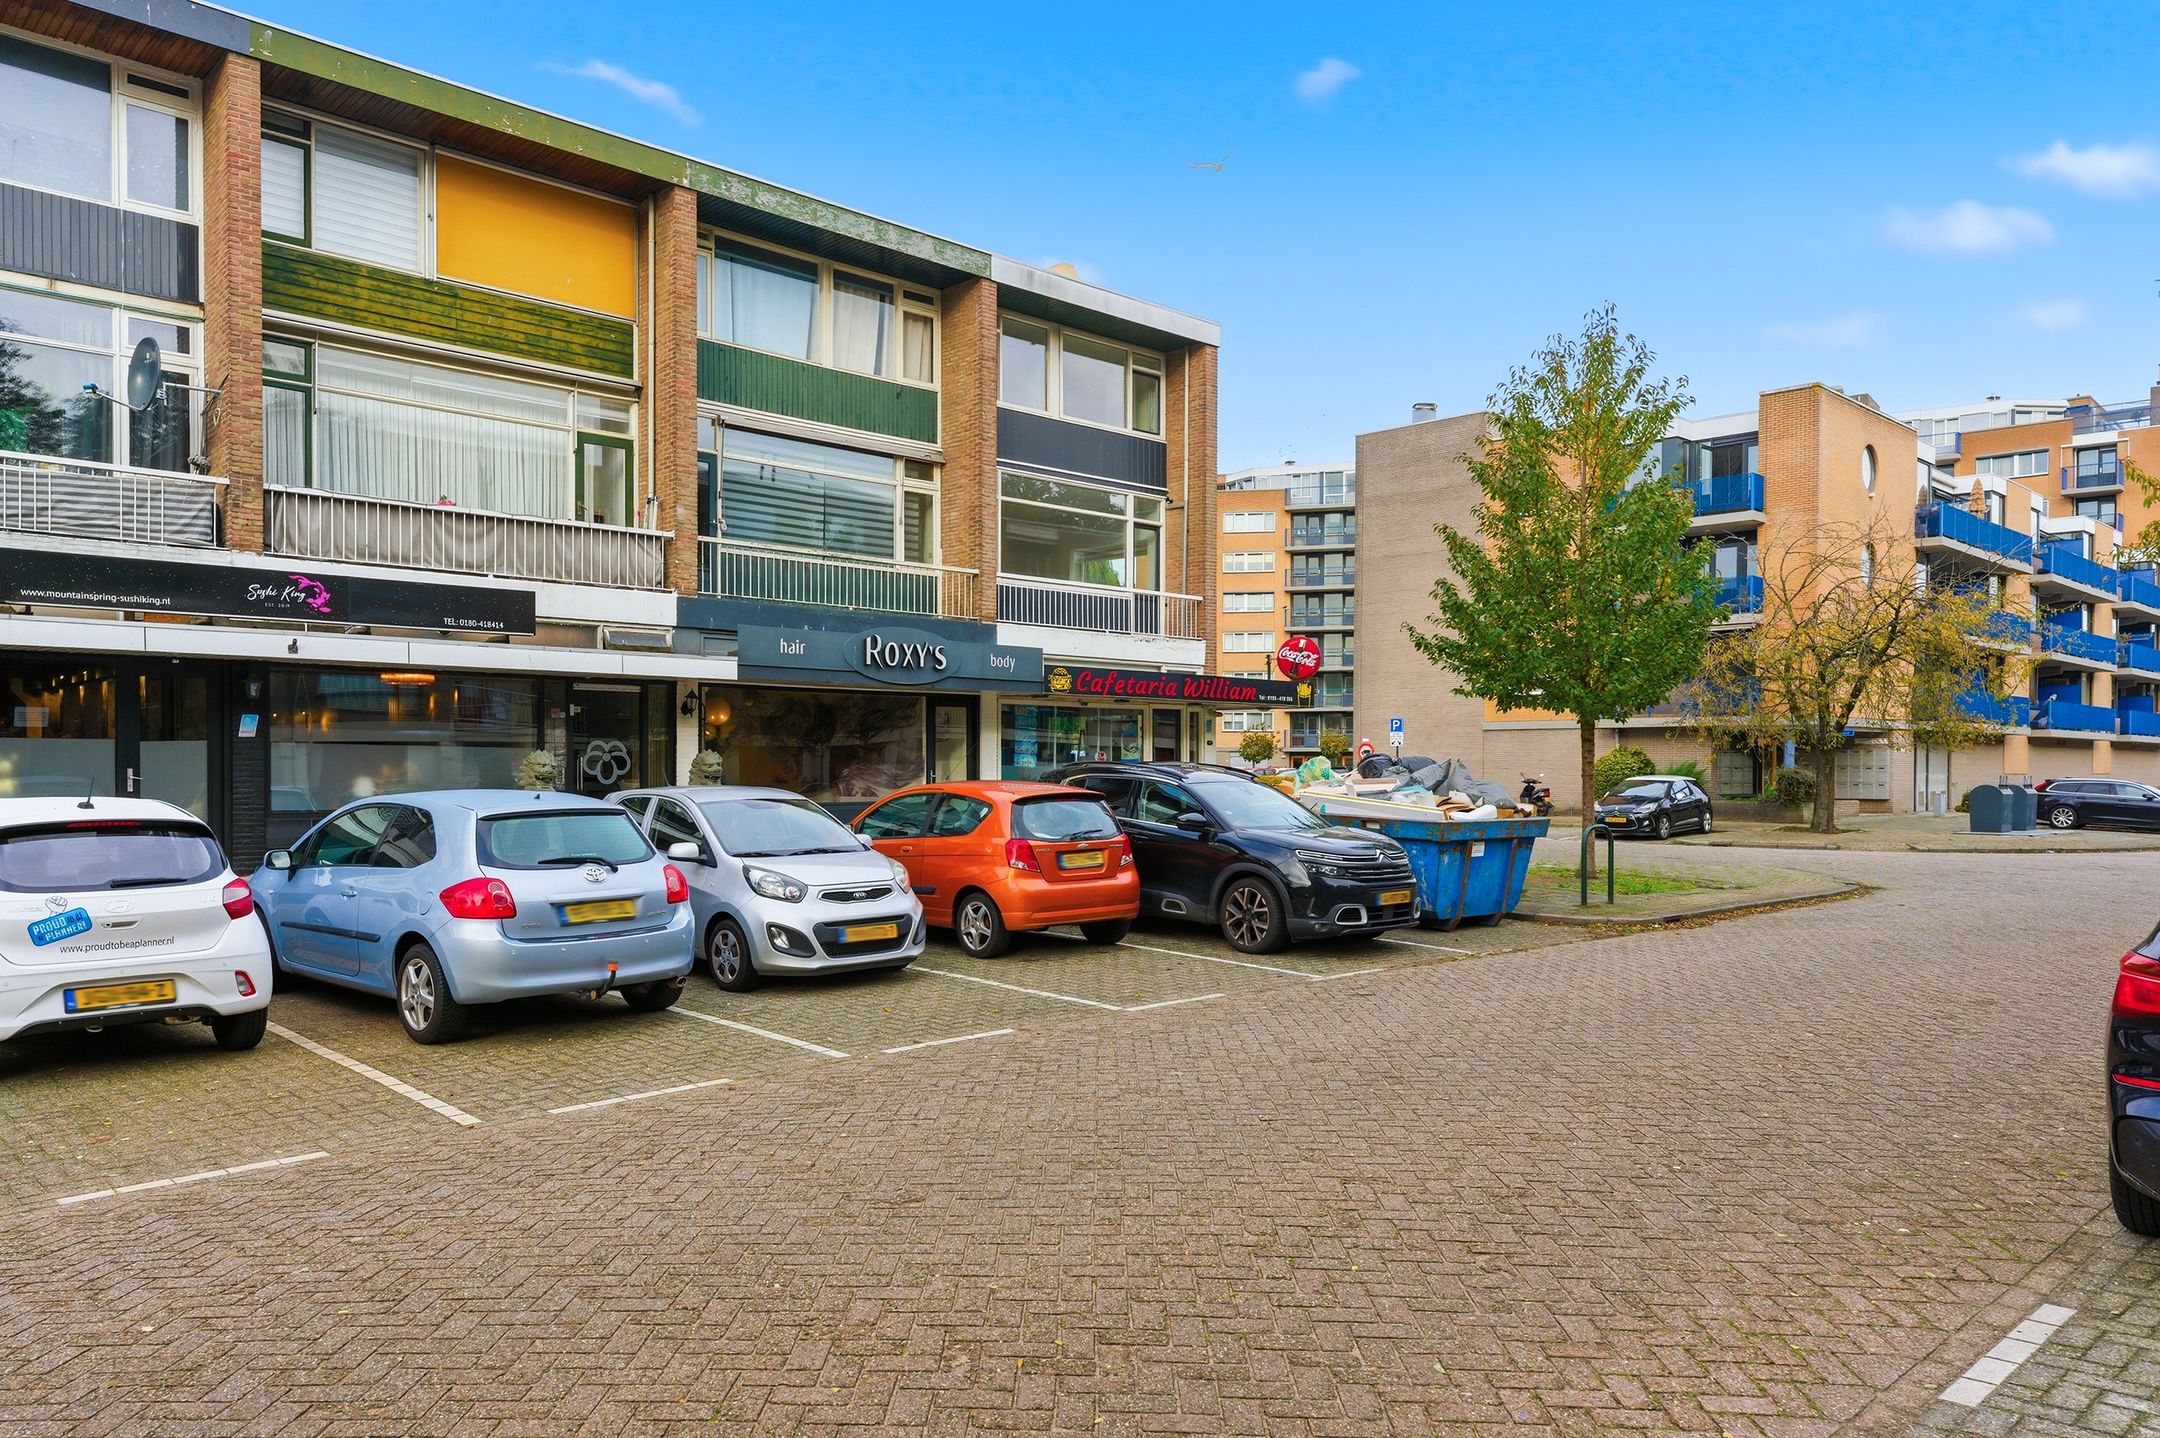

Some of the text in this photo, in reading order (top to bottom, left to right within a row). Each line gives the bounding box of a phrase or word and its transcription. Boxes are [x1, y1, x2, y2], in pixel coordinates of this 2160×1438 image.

[247, 584, 306, 603] Sushi King
[779, 637, 806, 655] hair
[864, 633, 948, 671] ROXY'S
[990, 653, 1016, 673] body
[1076, 670, 1257, 701] Cafetaria William
[1392, 720, 1401, 731] P
[32, 917, 67, 936] PROUD
[45, 921, 87, 941] PLANNER!
[59, 935, 175, 954] www.proudtobeaplanner.nl
